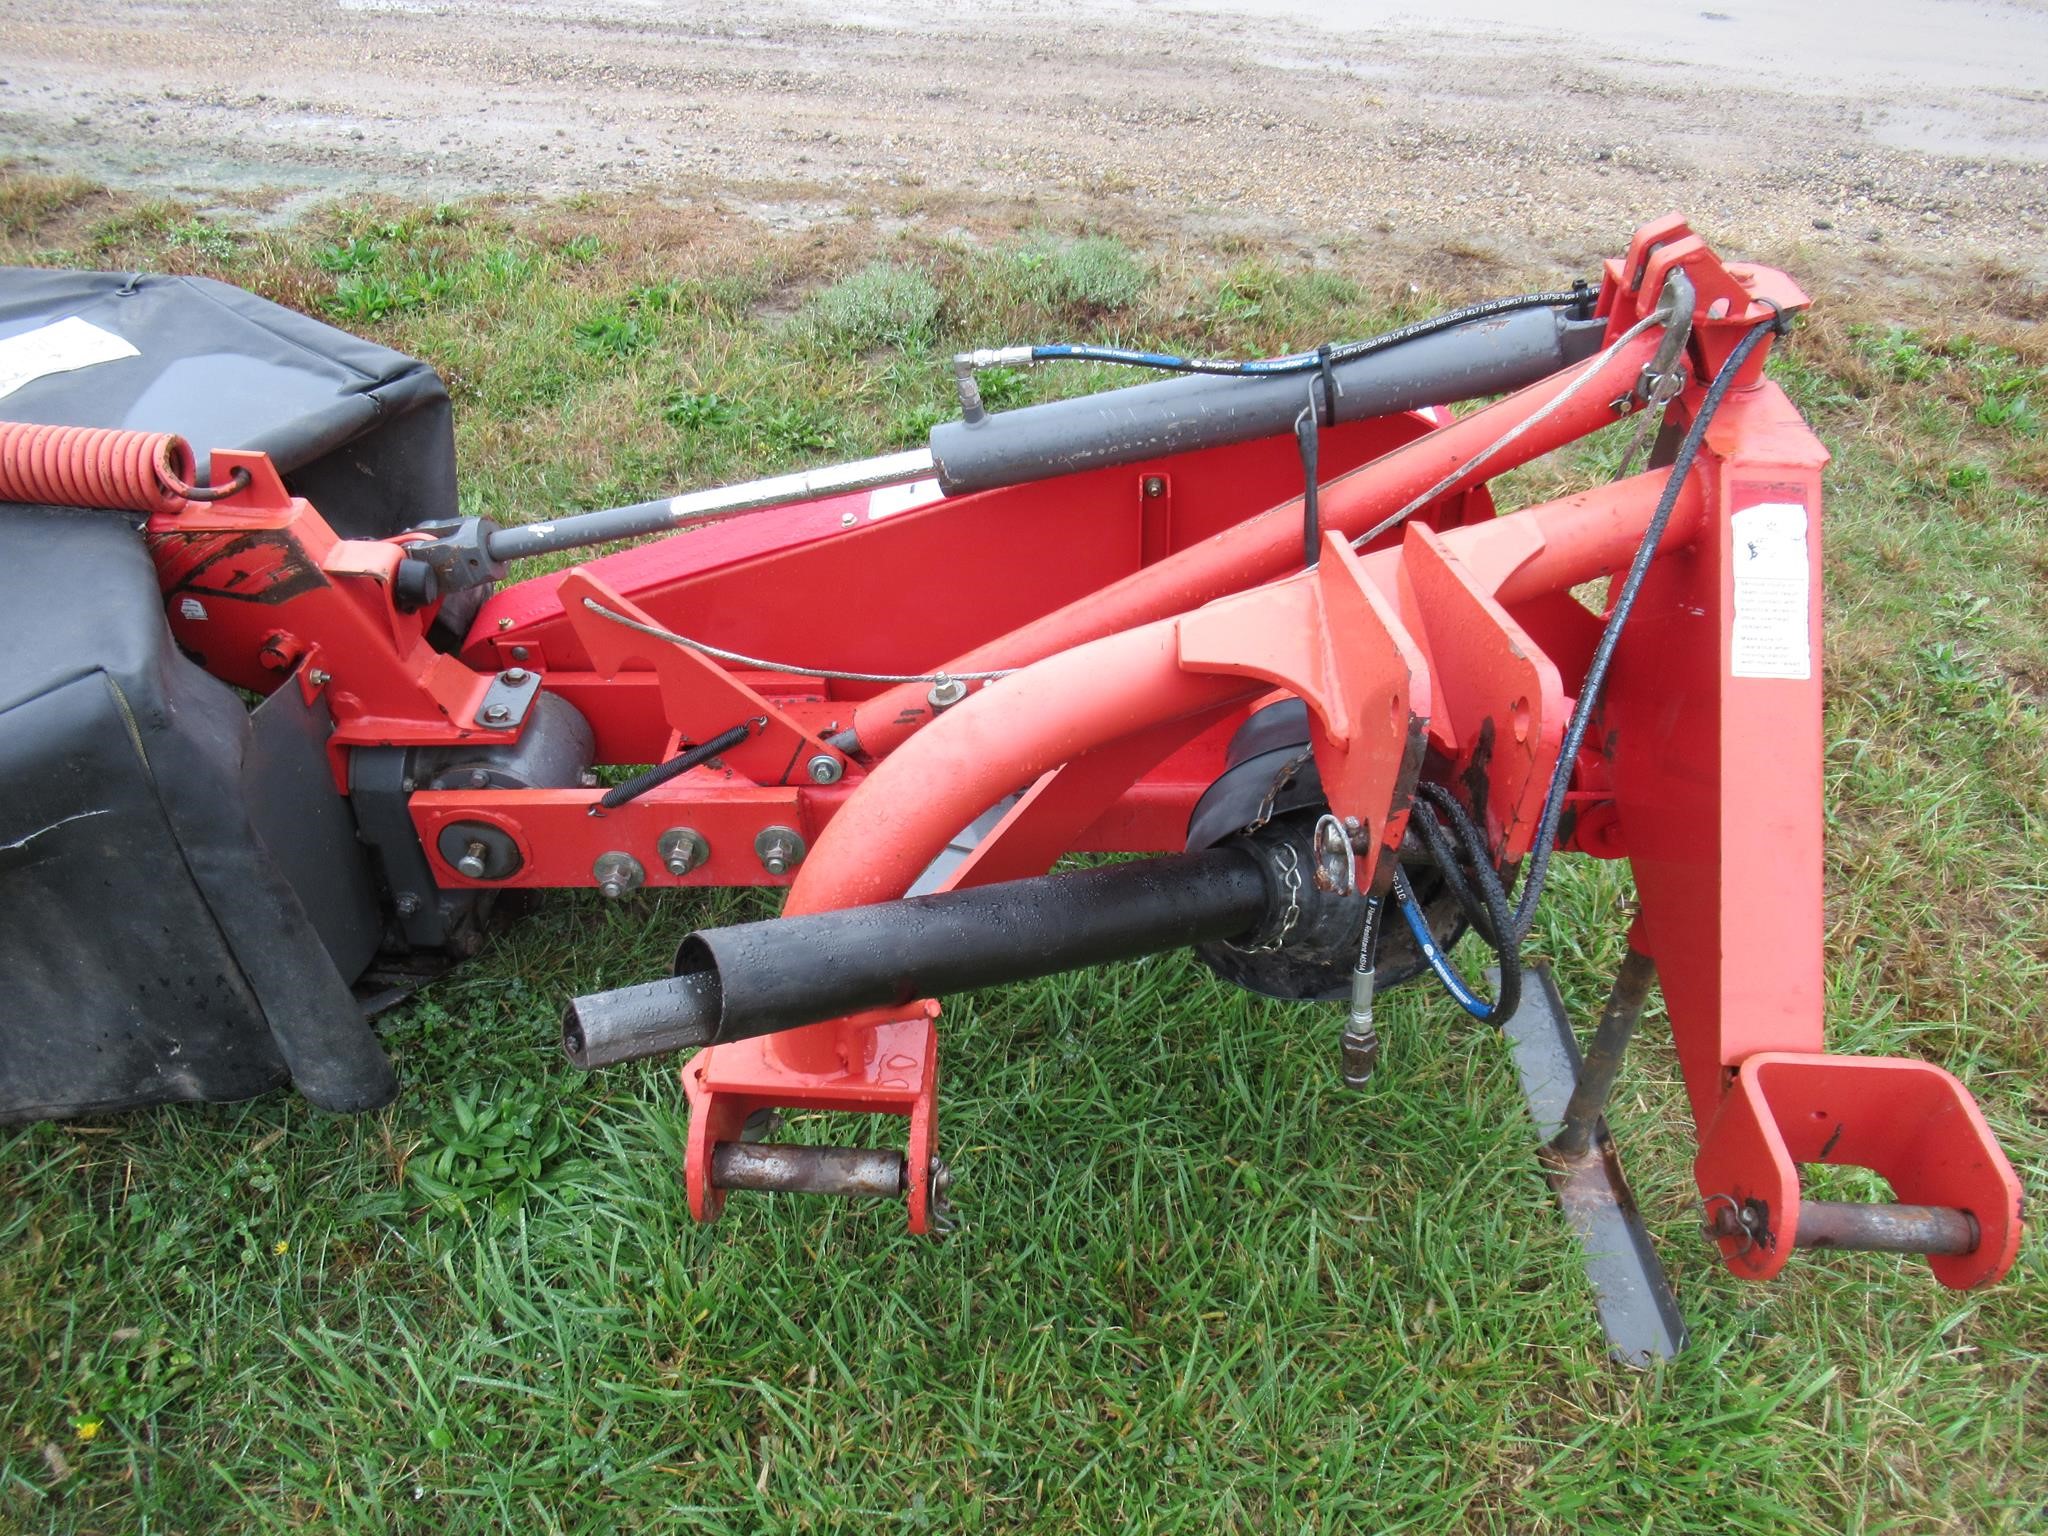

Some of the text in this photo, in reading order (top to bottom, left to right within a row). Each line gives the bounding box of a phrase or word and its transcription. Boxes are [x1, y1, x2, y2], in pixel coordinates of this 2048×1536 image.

[1560, 292, 1576, 301] Type
[1358, 905, 1376, 971] Flame Resistant MSHA
